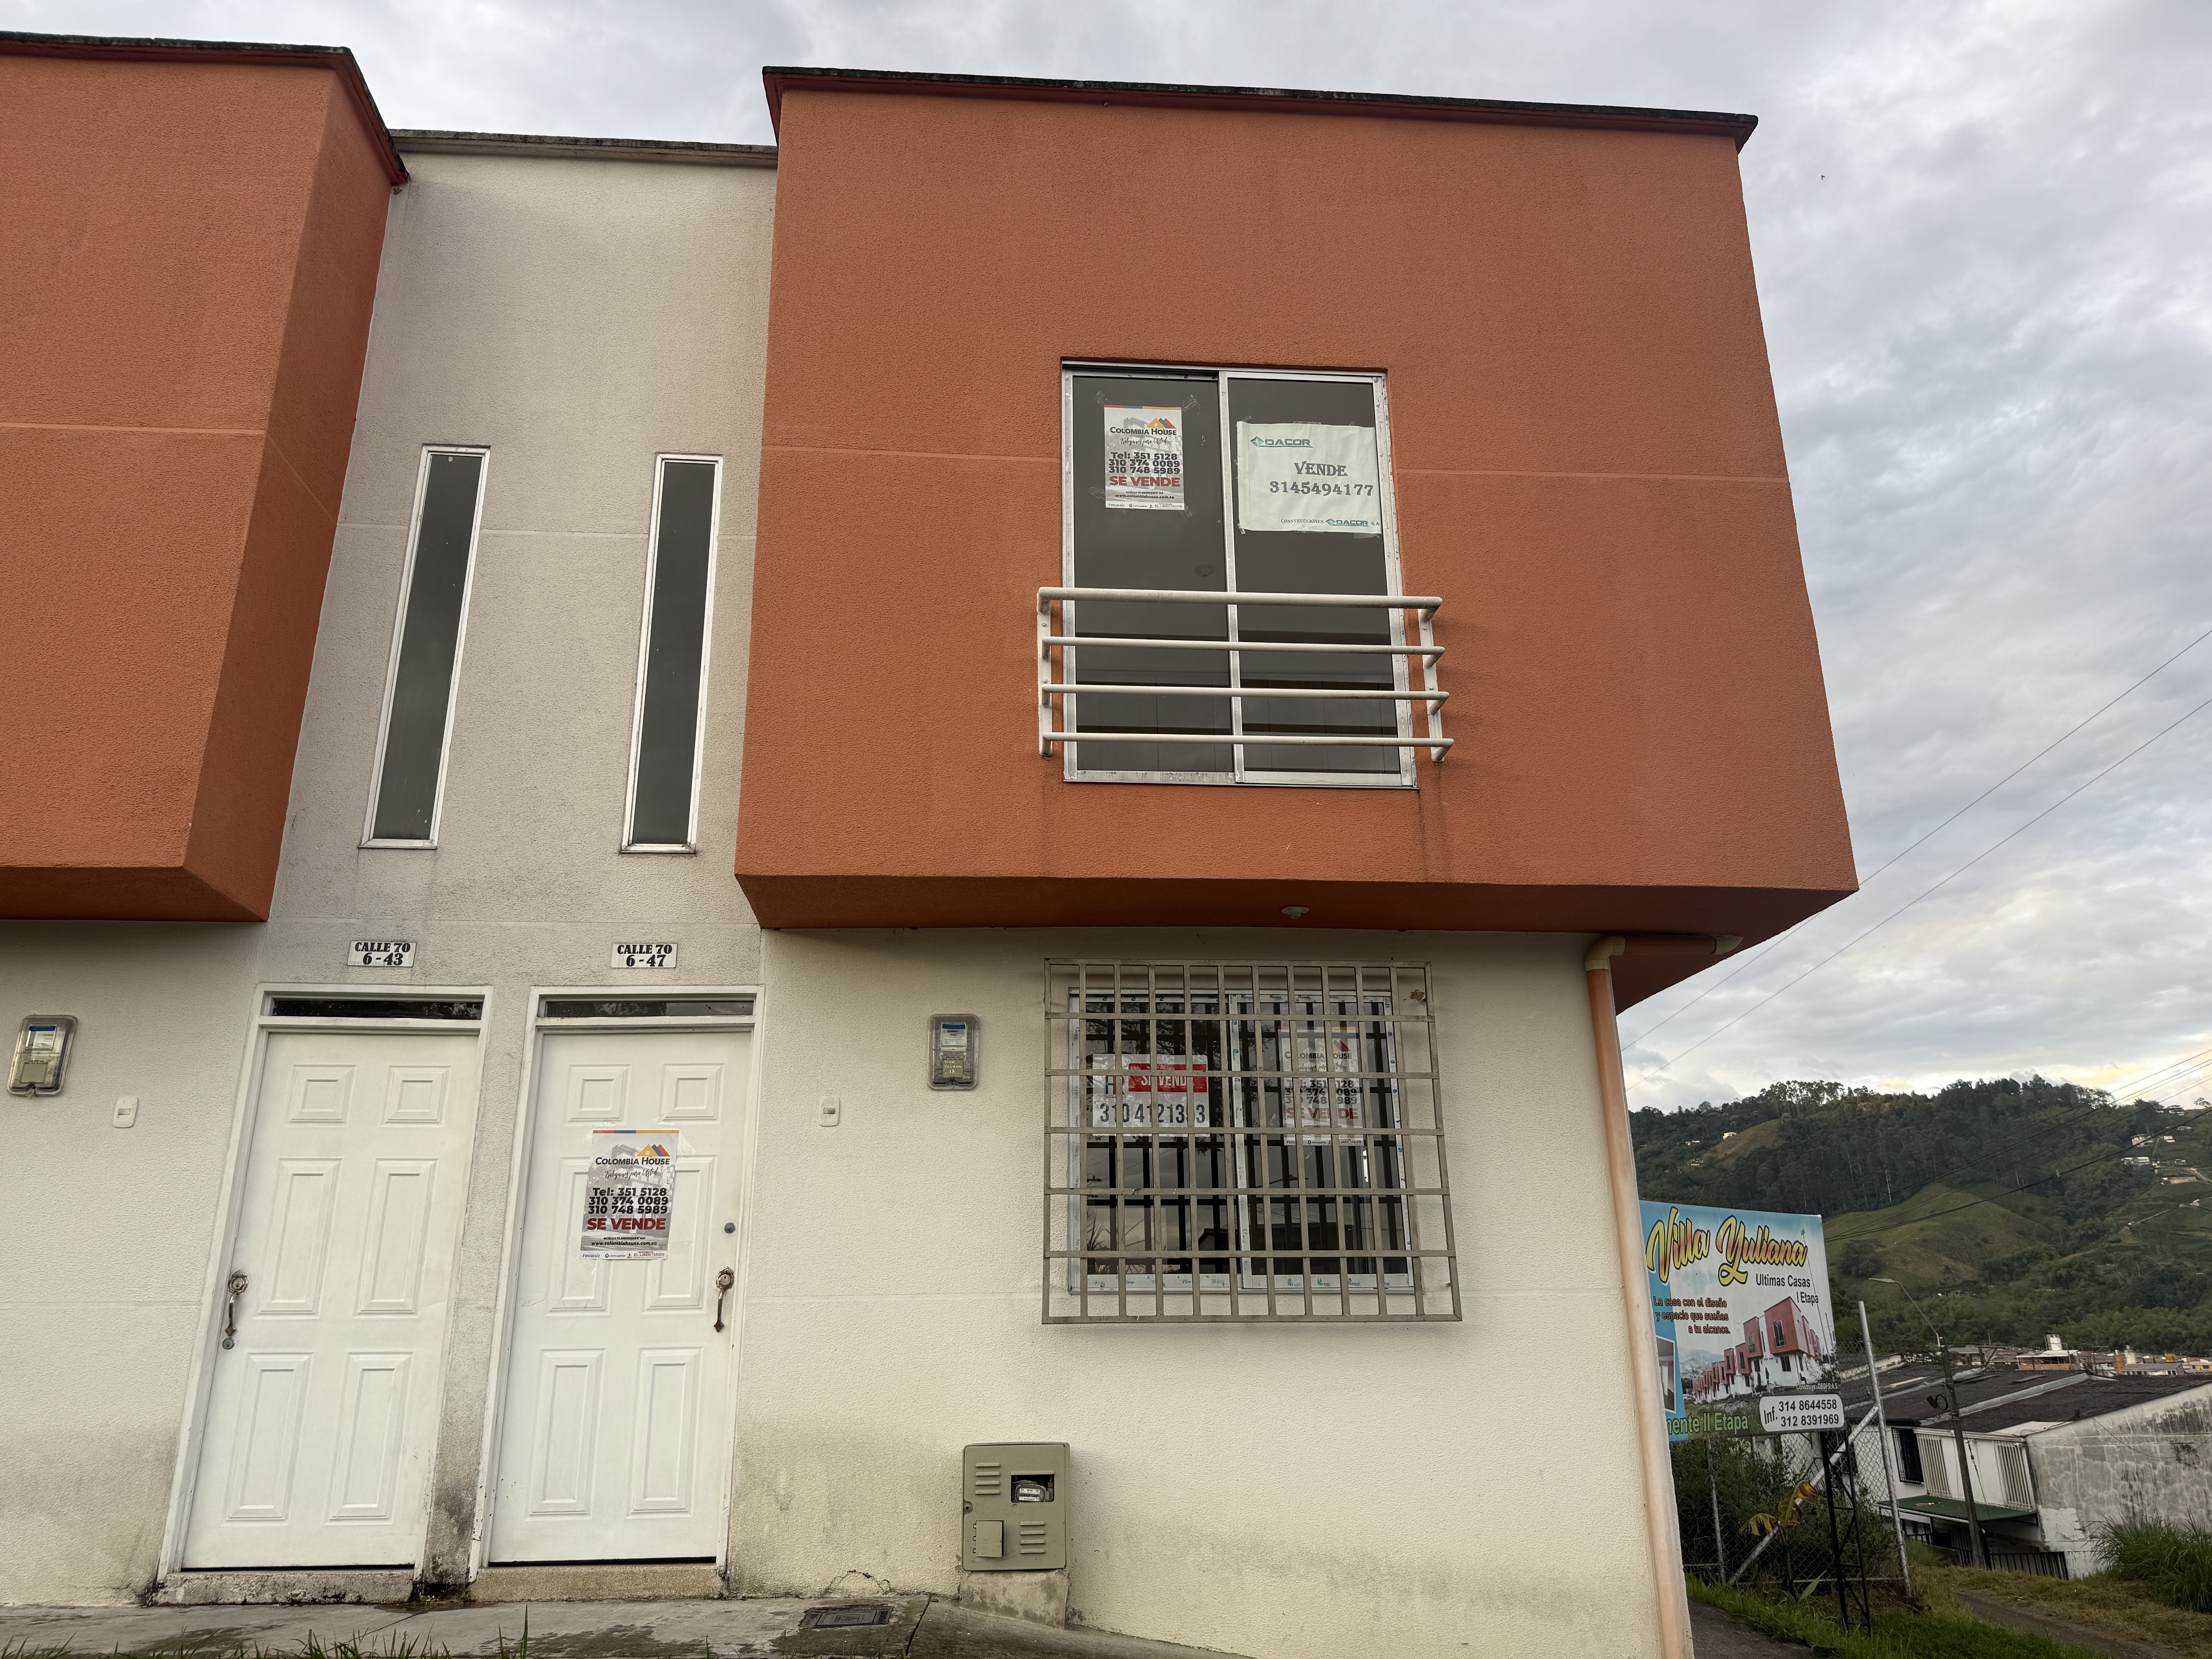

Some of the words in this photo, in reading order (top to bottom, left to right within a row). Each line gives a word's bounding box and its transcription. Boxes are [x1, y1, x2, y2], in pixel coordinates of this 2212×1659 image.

[1293, 461, 1348, 477] VENDE
[1109, 476, 1127, 486] SE
[1130, 477, 1180, 487] VENDE
[1269, 481, 1373, 496] 3145494177
[355, 942, 391, 952] CALLE
[394, 943, 410, 953] 70
[618, 945, 653, 954] CALLE
[656, 944, 672, 954] 70
[1158, 1075, 1194, 1086] VEND
[1310, 1080, 1327, 1088] 351
[1336, 1080, 1355, 1088] 128
[1336, 1088, 1357, 1096] 089
[1307, 1096, 1327, 1104] 748
[1307, 1108, 1358, 1119] VEDE
[595, 1157, 639, 1165] COLOMBIA
[592, 1187, 614, 1196] Tel:
[618, 1188, 636, 1196] 351
[640, 1188, 667, 1196] 5128
[588, 1197, 608, 1205] 310
[612, 1197, 634, 1205] 374
[637, 1196, 669, 1205] 0089
[588, 1206, 608, 1214] 310
[612, 1206, 634, 1214] 748
[637, 1205, 668, 1214] 5989
[587, 1218, 607, 1230] SE
[611, 1218, 666, 1230] VENDE
[1646, 1206, 1711, 1283] Villa
[1716, 1214, 1808, 1286] Yuliana
[1756, 1273, 1785, 1286] Ultimas
[1788, 1275, 1810, 1288] Casas
[1653, 1296, 1663, 1306] La
[1664, 1298, 1681, 1306] casa
[1683, 1298, 1695, 1307] con
[1697, 1297, 1704, 1307] el
[1705, 1297, 1727, 1308] diseño
[1800, 1291, 1819, 1306] Etapa
[1655, 1312, 1660, 1322] y
[1662, 1310, 1688, 1322] espacio
[1690, 1312, 1703, 1322] que
[1704, 1310, 1729, 1321] sueñas
[1688, 1325, 1693, 1334] a
[1694, 1324, 1702, 1334] tu
[1703, 1324, 1730, 1334] alcance.
[1779, 1400, 1796, 1412] 314
[1799, 1399, 1837, 1410] 8644558
[1764, 1406, 1778, 1424] Inf.
[1781, 1416, 1798, 1427] 312
[1801, 1414, 1839, 1426] 8391969
[1714, 1412, 1748, 1434] Etapa
